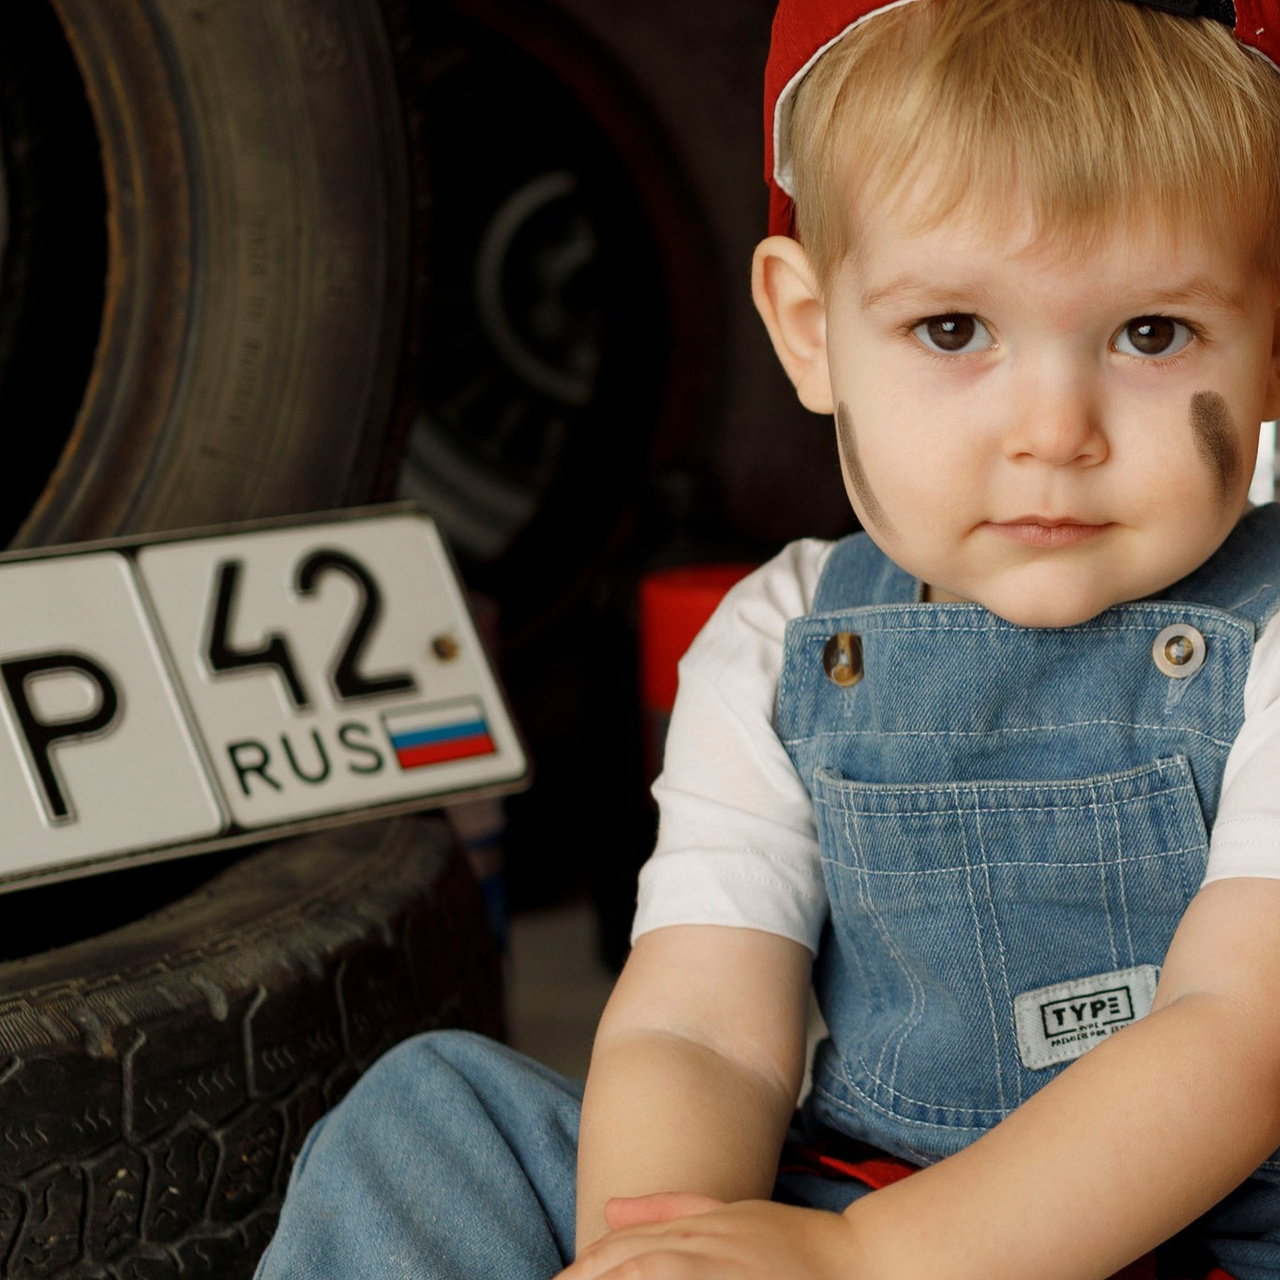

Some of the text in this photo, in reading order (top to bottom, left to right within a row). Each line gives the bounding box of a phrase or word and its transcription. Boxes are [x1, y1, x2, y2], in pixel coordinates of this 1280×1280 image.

[208, 548, 416, 710] 42
[226, 722, 385, 797] RUS
[1052, 996, 1121, 1026] TYPE
